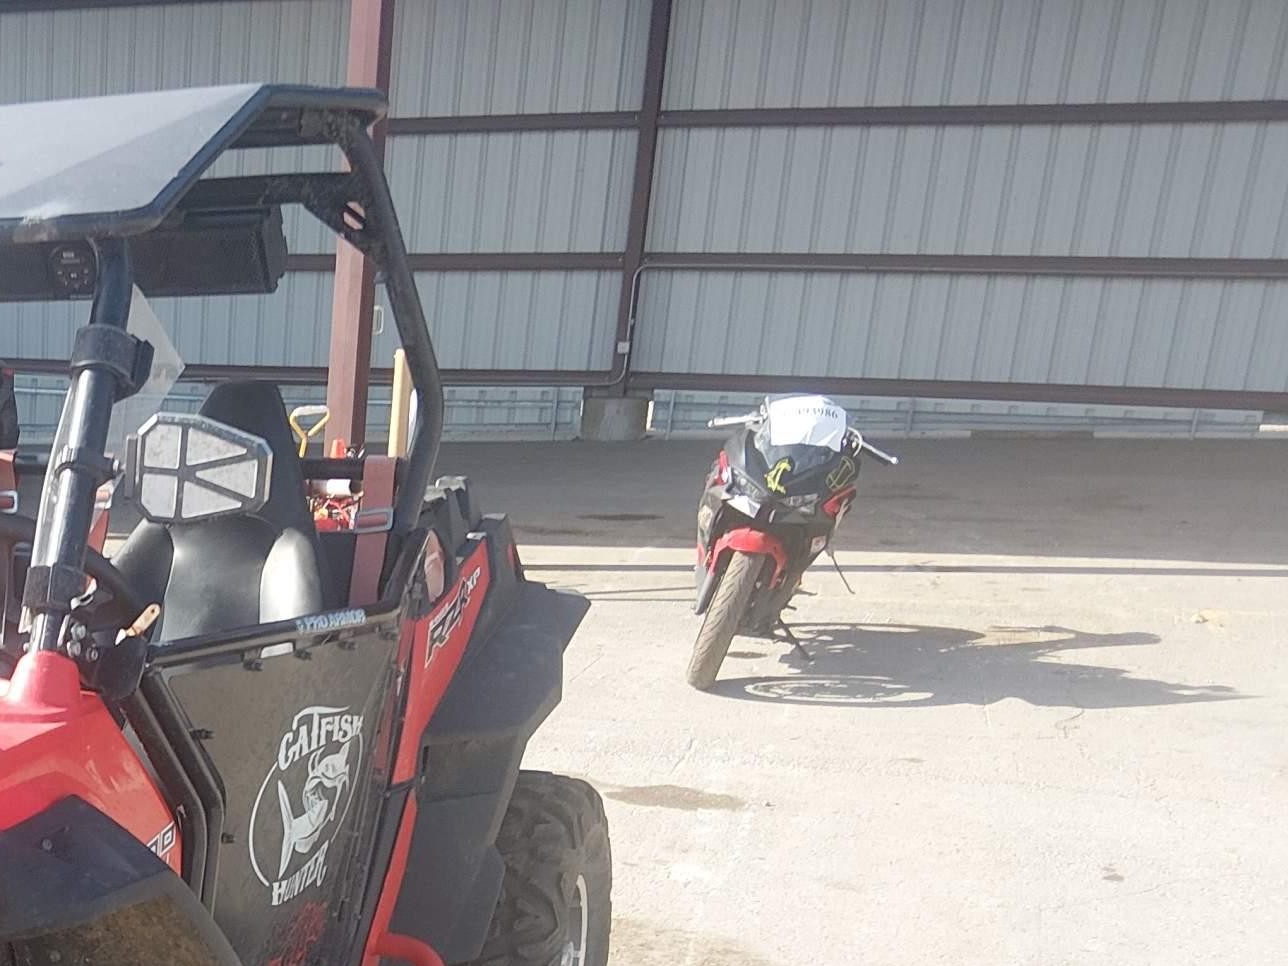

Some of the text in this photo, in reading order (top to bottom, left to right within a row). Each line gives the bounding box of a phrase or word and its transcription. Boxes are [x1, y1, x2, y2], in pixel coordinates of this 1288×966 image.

[466, 567, 481, 594] XP
[328, 608, 367, 630] ARMOR
[271, 839, 328, 906] HUNTER
